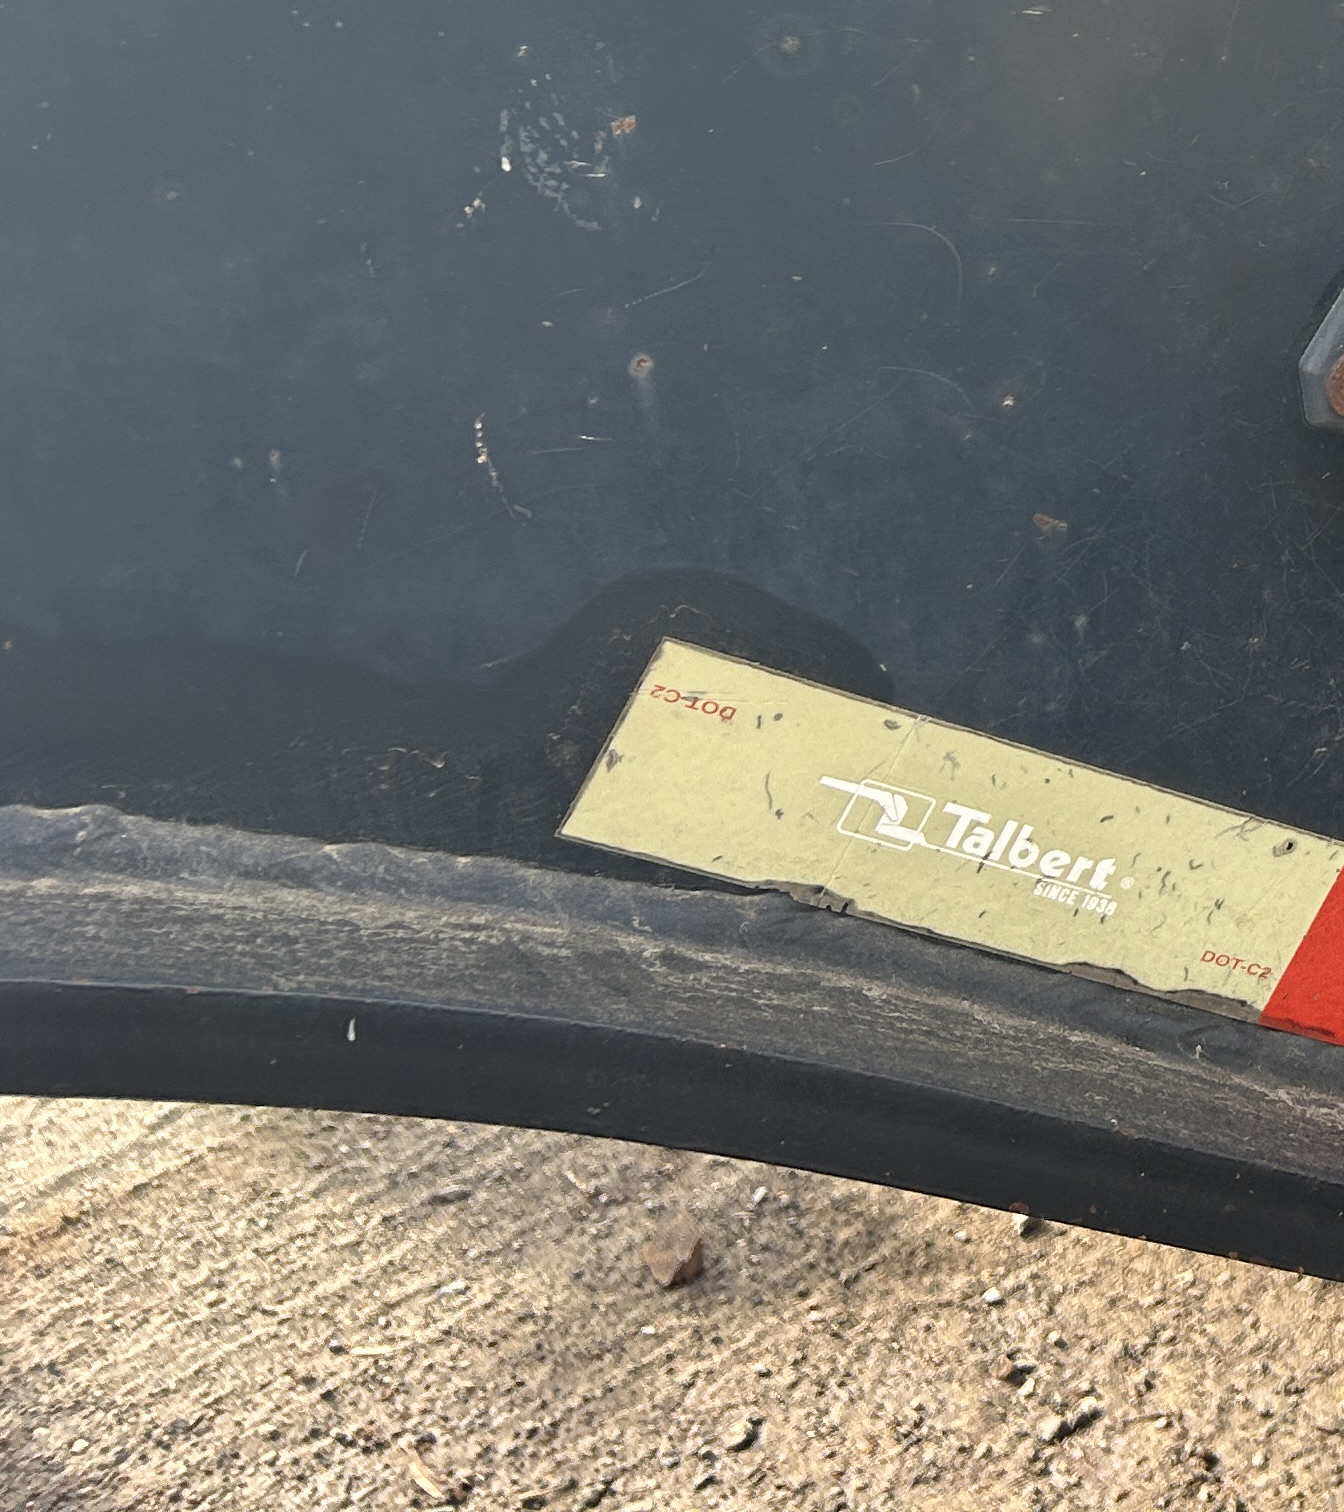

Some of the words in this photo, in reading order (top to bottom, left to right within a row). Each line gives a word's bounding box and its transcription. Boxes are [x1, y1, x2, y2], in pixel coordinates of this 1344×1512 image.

[649, 684, 738, 721] DOT-C2
[942, 801, 1117, 891] Talbert
[1033, 881, 1080, 906] SINCE
[1081, 894, 1118, 916] 1938
[1199, 948, 1273, 981] DOT-C2
